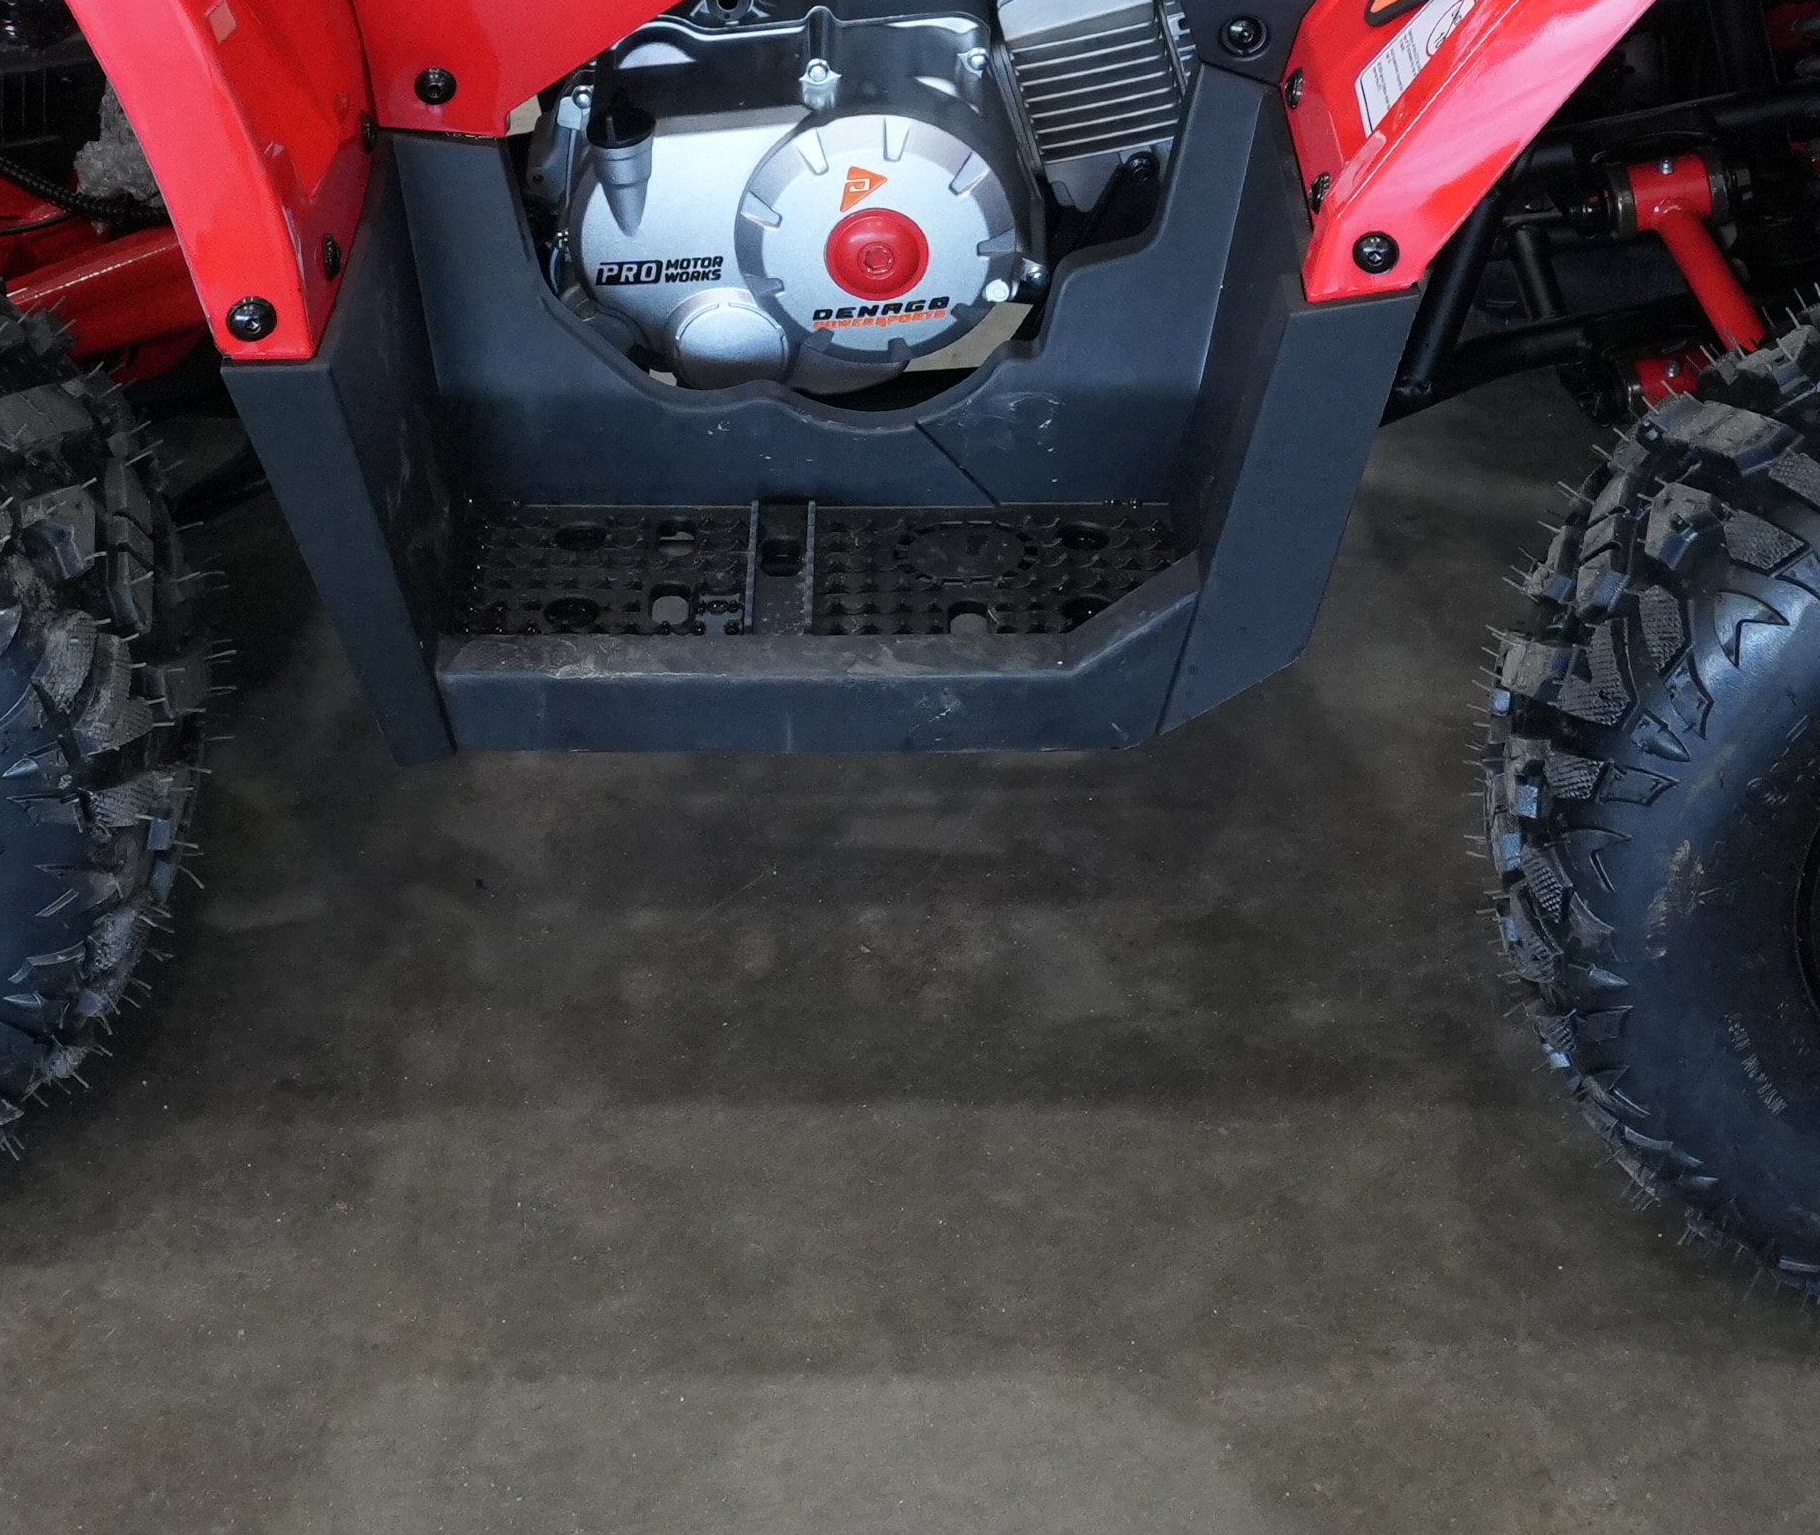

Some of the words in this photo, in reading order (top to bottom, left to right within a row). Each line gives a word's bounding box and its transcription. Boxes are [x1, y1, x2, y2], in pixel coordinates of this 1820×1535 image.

[600, 262, 659, 284] PRO
[665, 255, 724, 271] MOTOR
[664, 268, 722, 284] WORKS
[812, 296, 951, 322] DENAGO
[812, 309, 948, 331] POWERSPORTS
